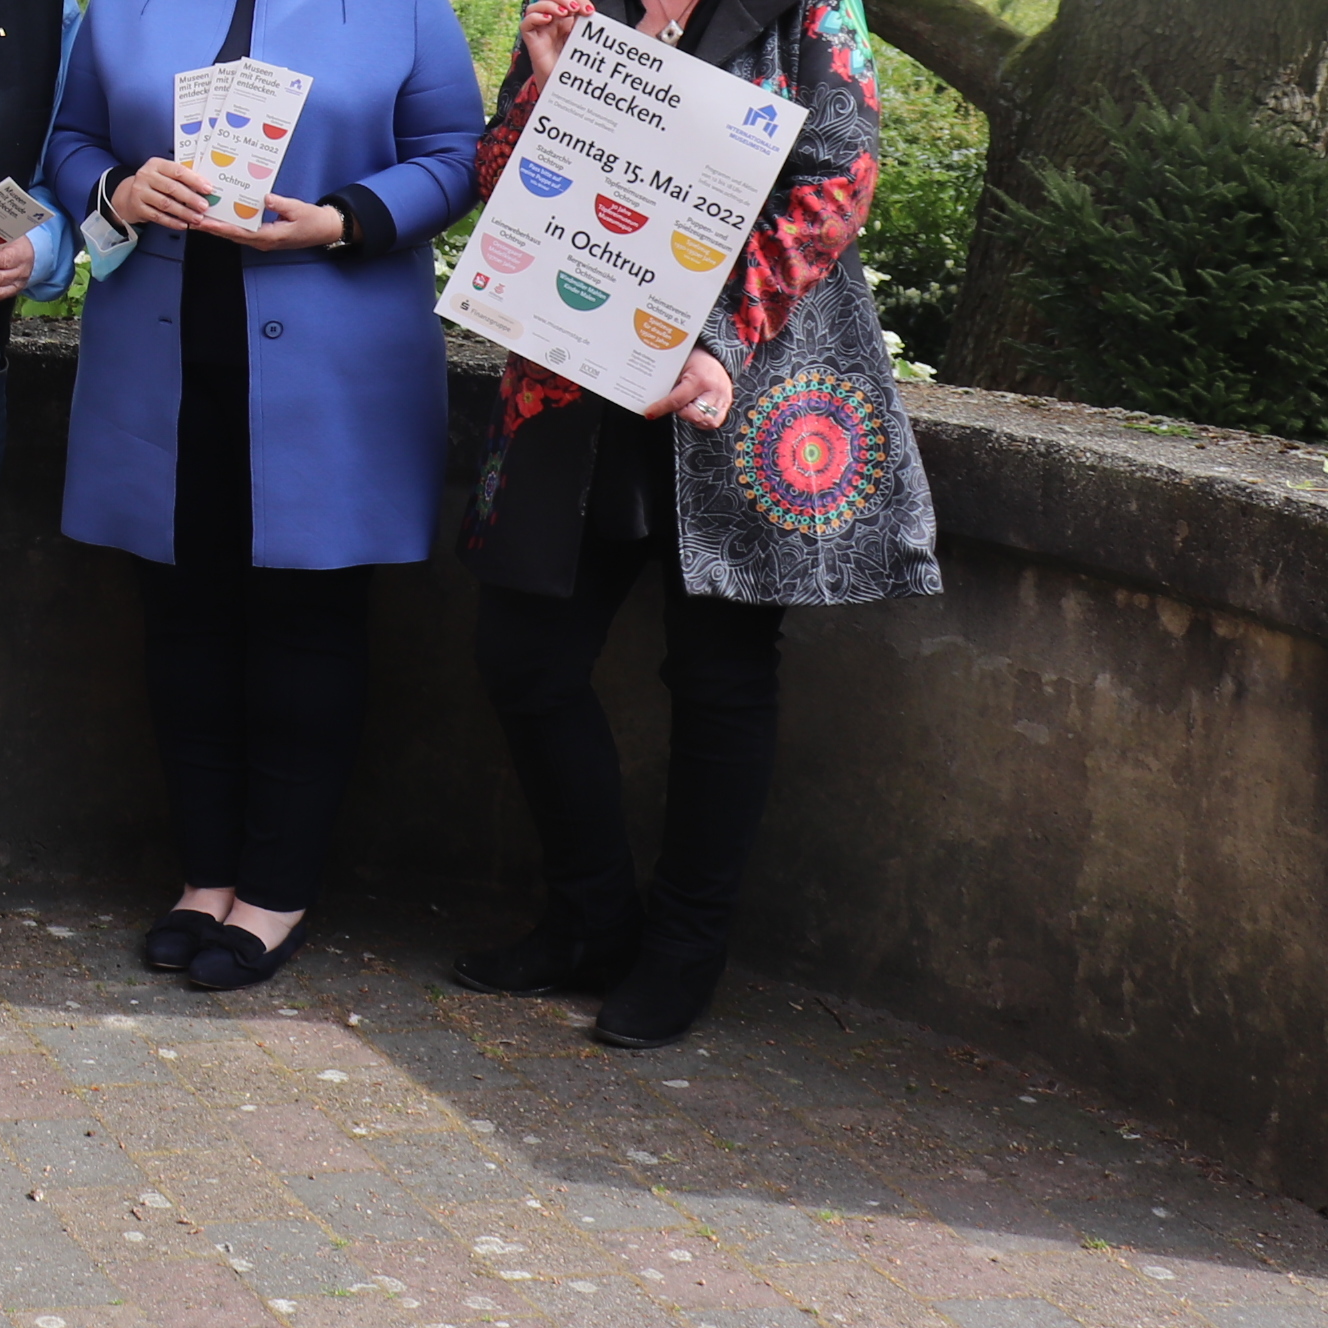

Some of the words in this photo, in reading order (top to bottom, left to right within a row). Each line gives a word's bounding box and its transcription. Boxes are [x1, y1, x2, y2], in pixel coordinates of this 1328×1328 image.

[580, 21, 664, 74] Museen
[237, 80, 277, 97] entdecken.
[240, 71, 252, 81] mit
[255, 76, 280, 88] Freude
[244, 62, 273, 77] Museen
[568, 43, 606, 75] mit
[609, 64, 682, 110] Freude
[558, 68, 666, 132] entdecken.
[217, 128, 230, 138] SO
[243, 136, 258, 147] Mai
[260, 143, 279, 154] 2022
[219, 173, 251, 190] Ochtrup
[533, 114, 619, 174] Sonntag
[624, 159, 644, 185] 15.
[649, 170, 692, 203] Mai
[693, 195, 746, 231] 2022
[544, 215, 566, 241] in
[571, 229, 655, 287] Ochtrup
